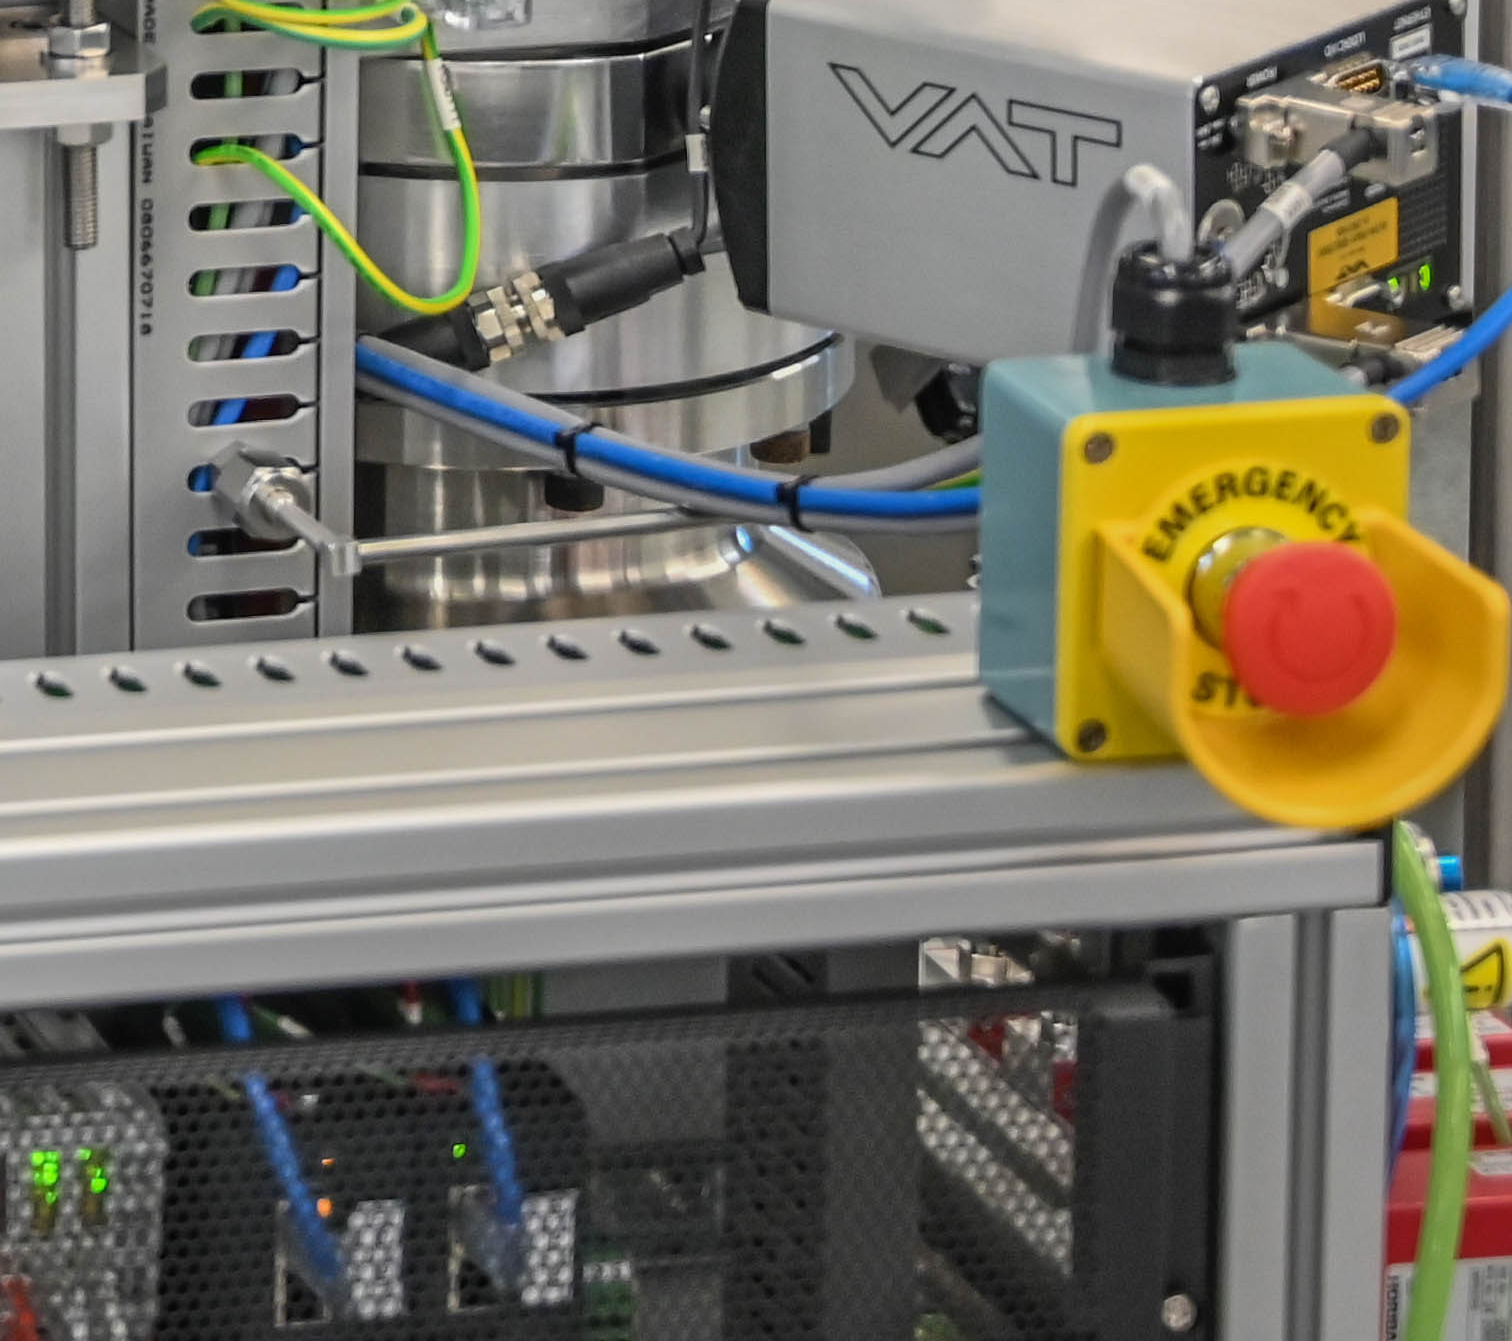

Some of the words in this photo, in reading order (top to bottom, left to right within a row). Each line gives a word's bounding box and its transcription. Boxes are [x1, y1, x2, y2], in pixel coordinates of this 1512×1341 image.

[141, 113, 154, 184] AIWAN
[828, 62, 1121, 187] VAT
[1142, 465, 1364, 563] EMERGENCY
